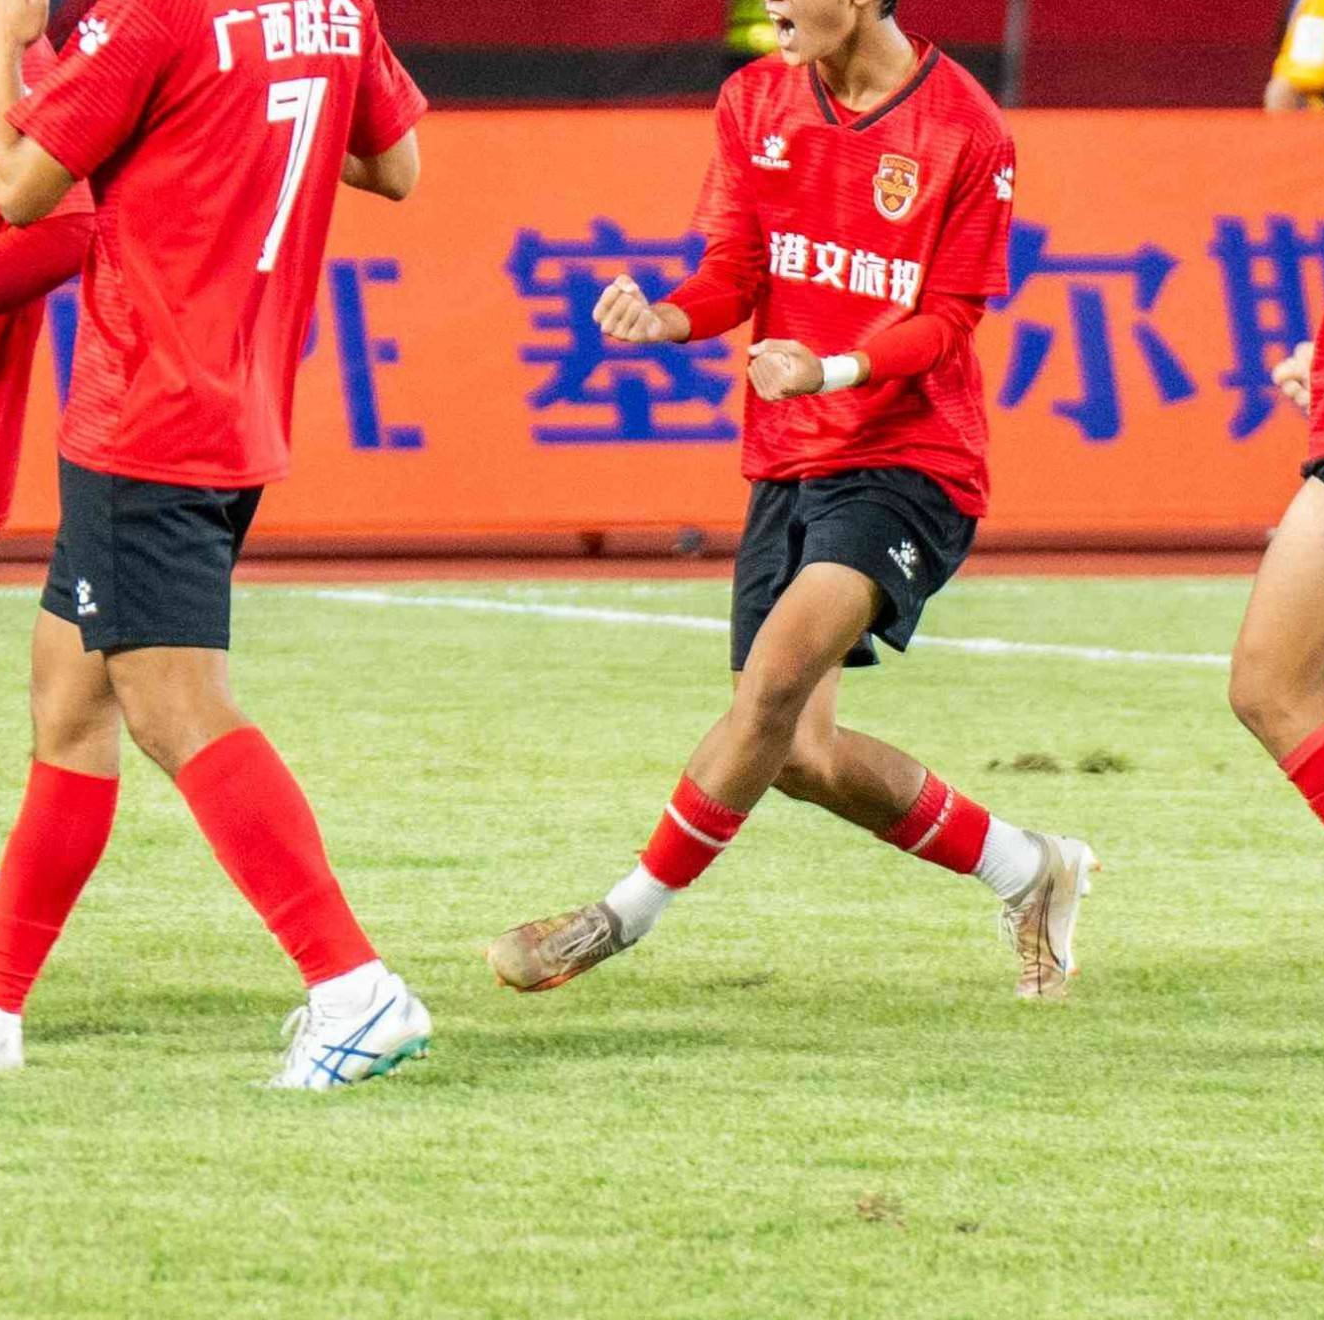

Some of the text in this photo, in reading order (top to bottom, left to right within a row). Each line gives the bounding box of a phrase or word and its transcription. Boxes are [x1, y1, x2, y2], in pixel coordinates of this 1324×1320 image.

[255, 77, 328, 273] 7
[750, 154, 791, 170] KELME
[769, 230, 923, 308] 港文旅投
